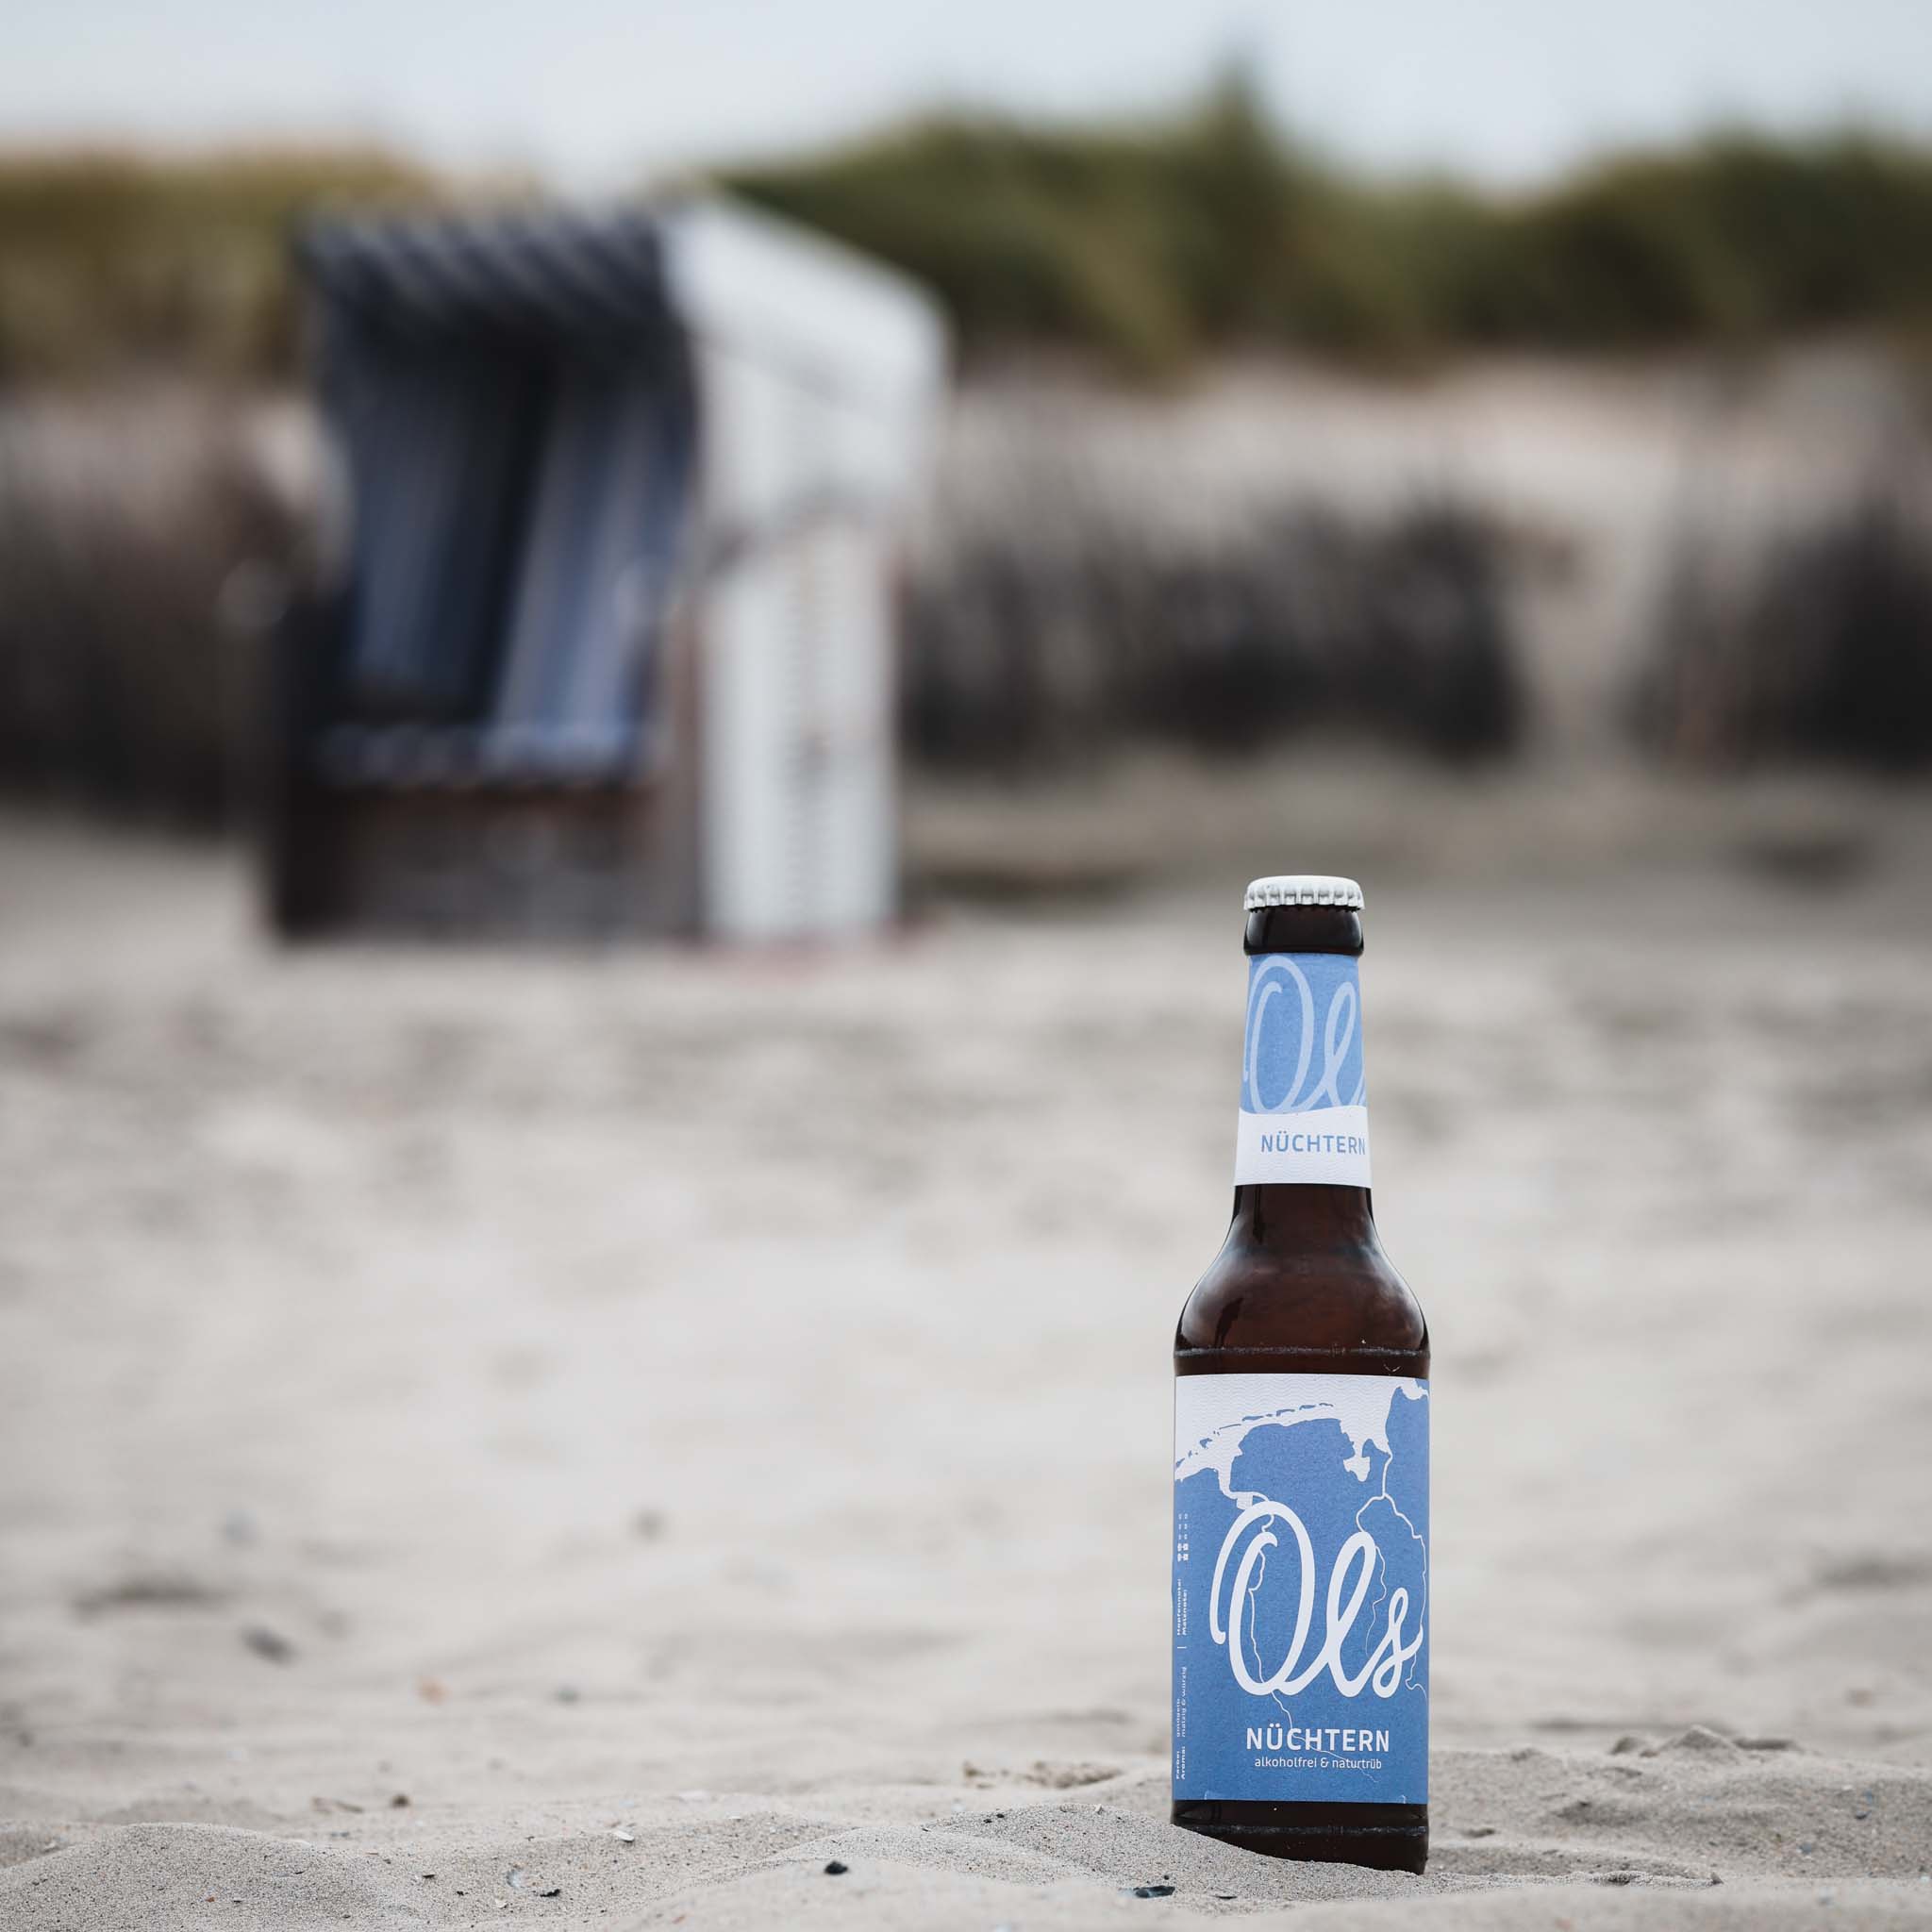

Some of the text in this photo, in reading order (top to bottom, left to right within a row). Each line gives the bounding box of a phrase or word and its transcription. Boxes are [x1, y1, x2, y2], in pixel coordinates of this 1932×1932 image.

[1243, 956, 1366, 1114] Ol
[1260, 1130, 1366, 1156] NÜCHTERN
[1209, 1500, 1424, 1698] Ols
[1245, 1723, 1390, 1752] NÜCHTERN
[1254, 1757, 1382, 1771] alkoholfrei & naturtrüb
